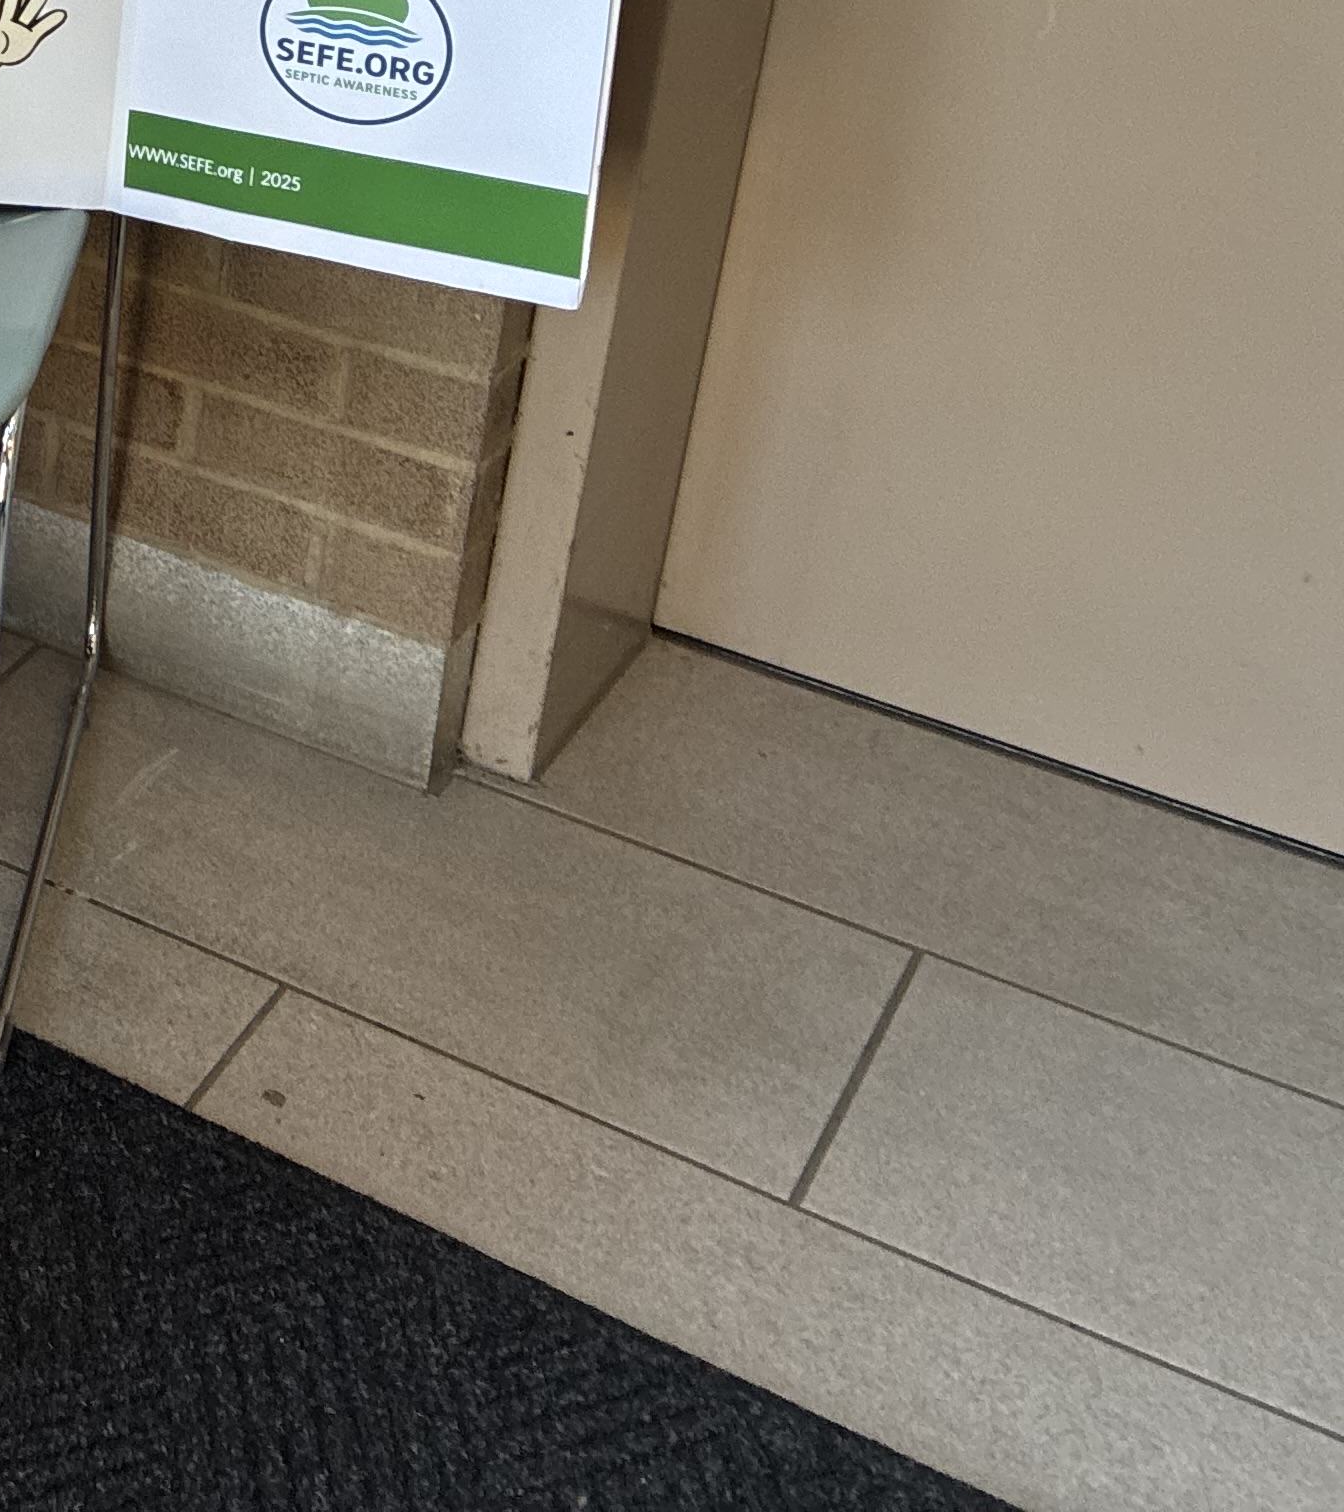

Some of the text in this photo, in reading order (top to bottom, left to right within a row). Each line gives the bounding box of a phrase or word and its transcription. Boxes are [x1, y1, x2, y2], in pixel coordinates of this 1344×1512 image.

[275, 37, 435, 86] SEFE.ORG
[284, 68, 418, 101] SEPTIC AWARENESS
[128, 143, 302, 192] WWW.SEFE.org 2025
